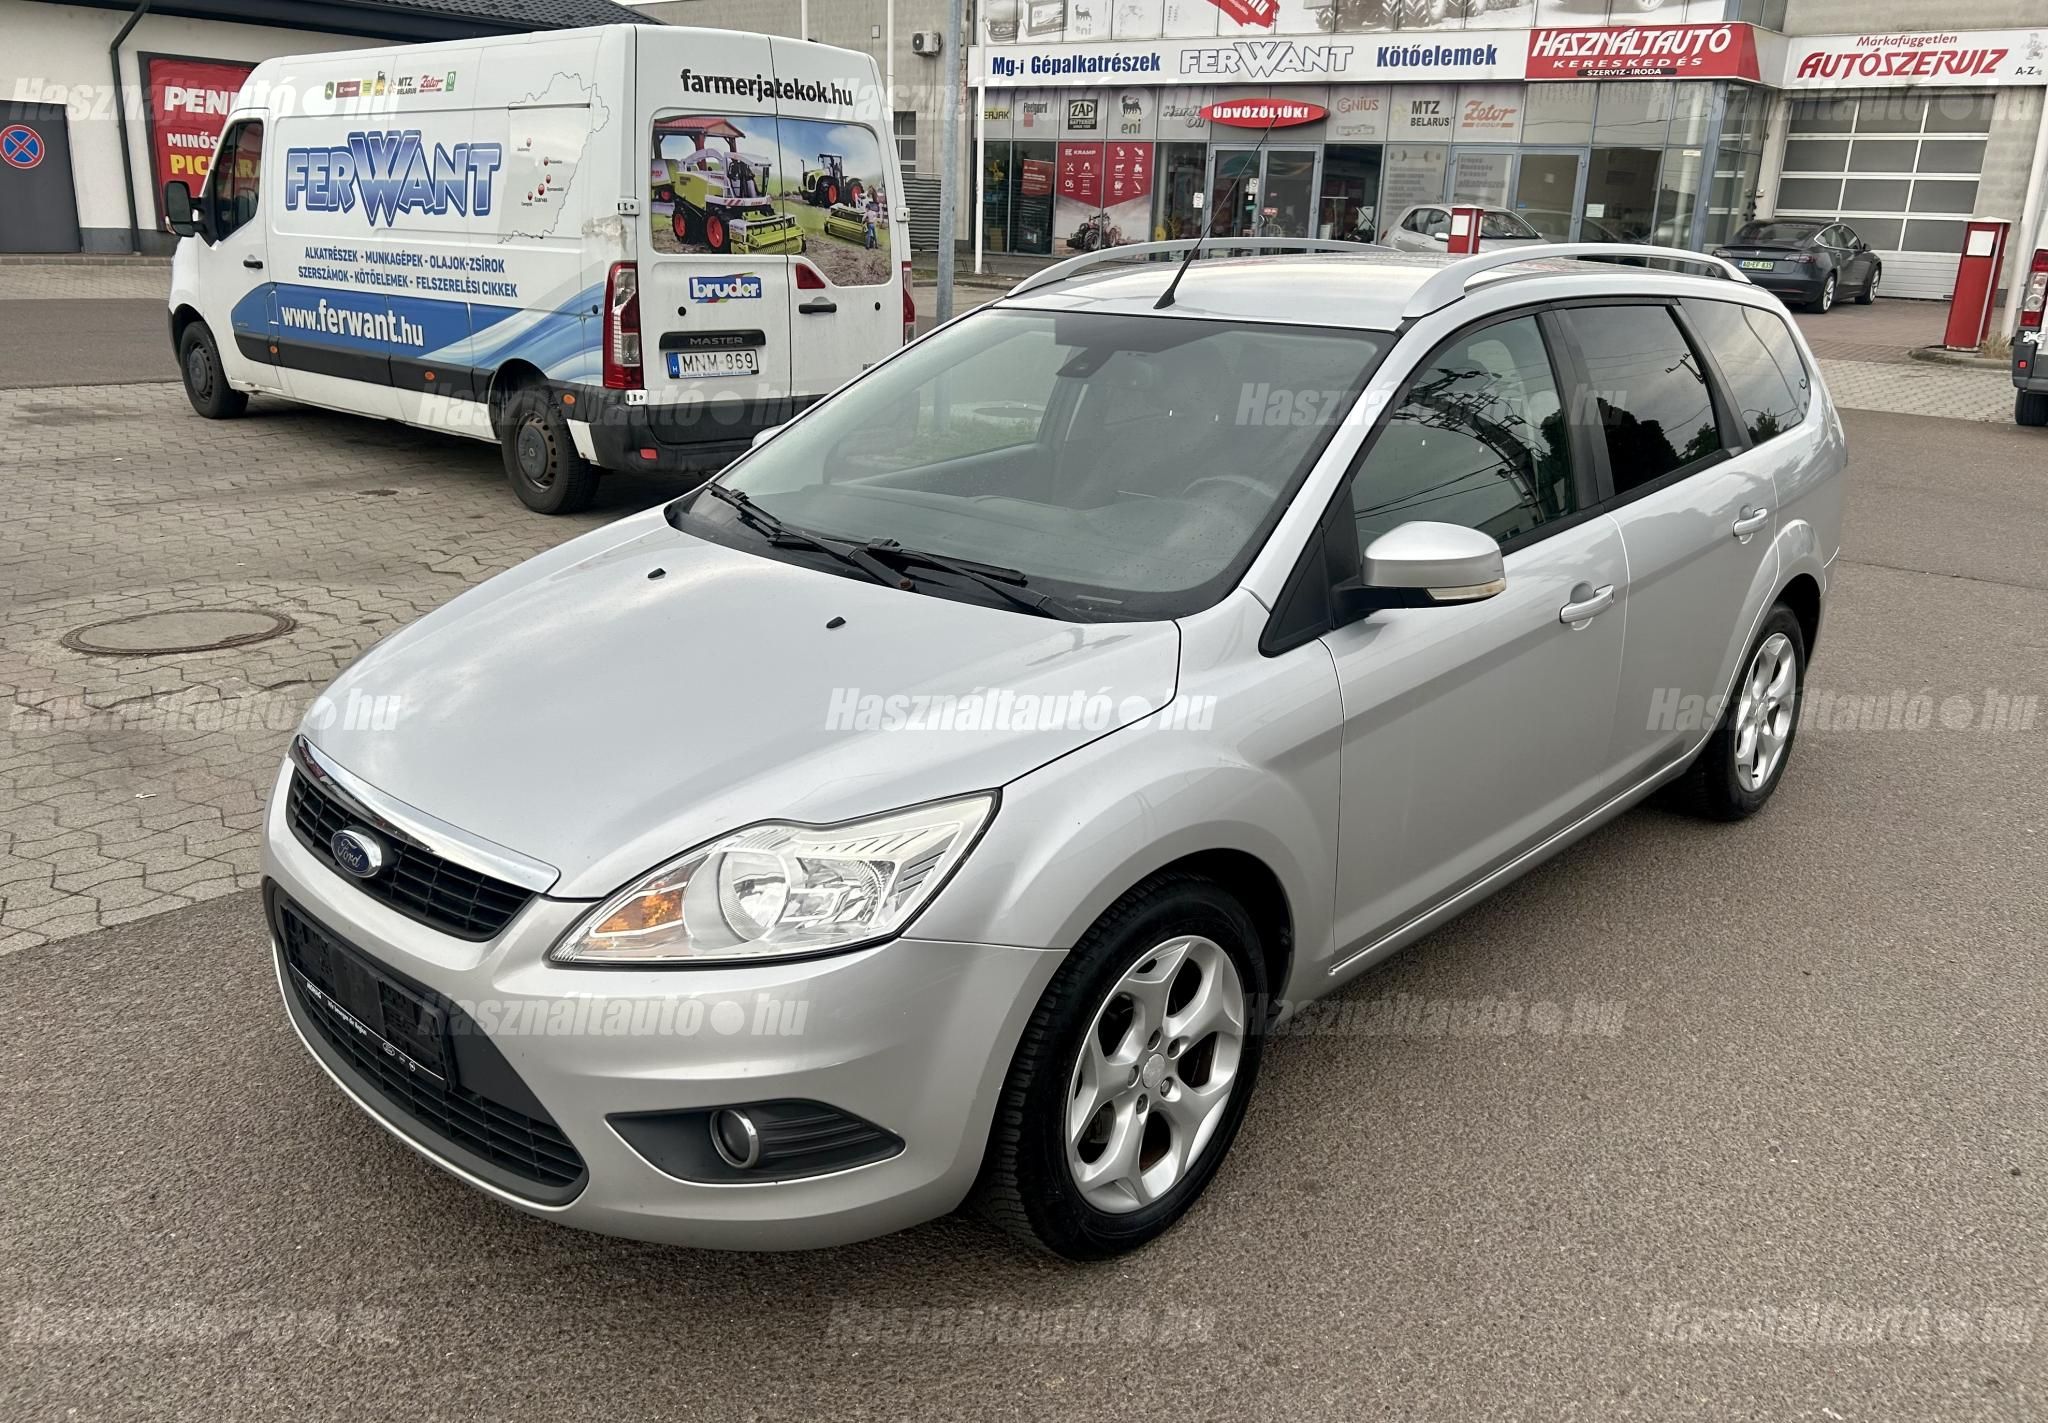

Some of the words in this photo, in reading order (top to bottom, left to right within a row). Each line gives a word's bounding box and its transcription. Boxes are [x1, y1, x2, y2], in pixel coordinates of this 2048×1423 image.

[1531, 24, 1732, 57] HASZNÁLTAUTÓ
[1856, 33, 1958, 48] Márkafüggetlen
[992, 57, 1024, 76] Mg-i
[1031, 52, 1161, 75] Gépalkatrészek
[1180, 41, 1353, 78] FERWANT
[1376, 44, 1498, 67] Kötőelemek
[1552, 57, 1703, 68] KERESKEDÉS
[1796, 47, 2009, 80] AUTÓSZERVIZ
[680, 69, 853, 106] farmerjatekok.hu
[1072, 103, 1093, 116] ZAP
[1212, 106, 1308, 119] ÜDVÖZÖLJÜK!
[1411, 101, 1440, 114] MTZ
[1464, 100, 1517, 121] Zetor
[1121, 119, 1141, 134] eni
[1410, 117, 1450, 127] BELARUS
[167, 131, 221, 149] MINŐS
[286, 130, 502, 227] FERWANT
[305, 246, 358, 262] ALKATRÉSZEK
[365, 250, 423, 267] MUNKAGÉPEK
[298, 265, 350, 283] SZERSZÁMOK
[416, 276, 481, 294] FELSZERELÉSI
[482, 282, 518, 297] CIKKEK
[693, 277, 759, 299] bruder
[281, 298, 425, 347] www.ferwant.hu
[690, 336, 743, 346] MASTER
[338, 838, 362, 867] Ford
